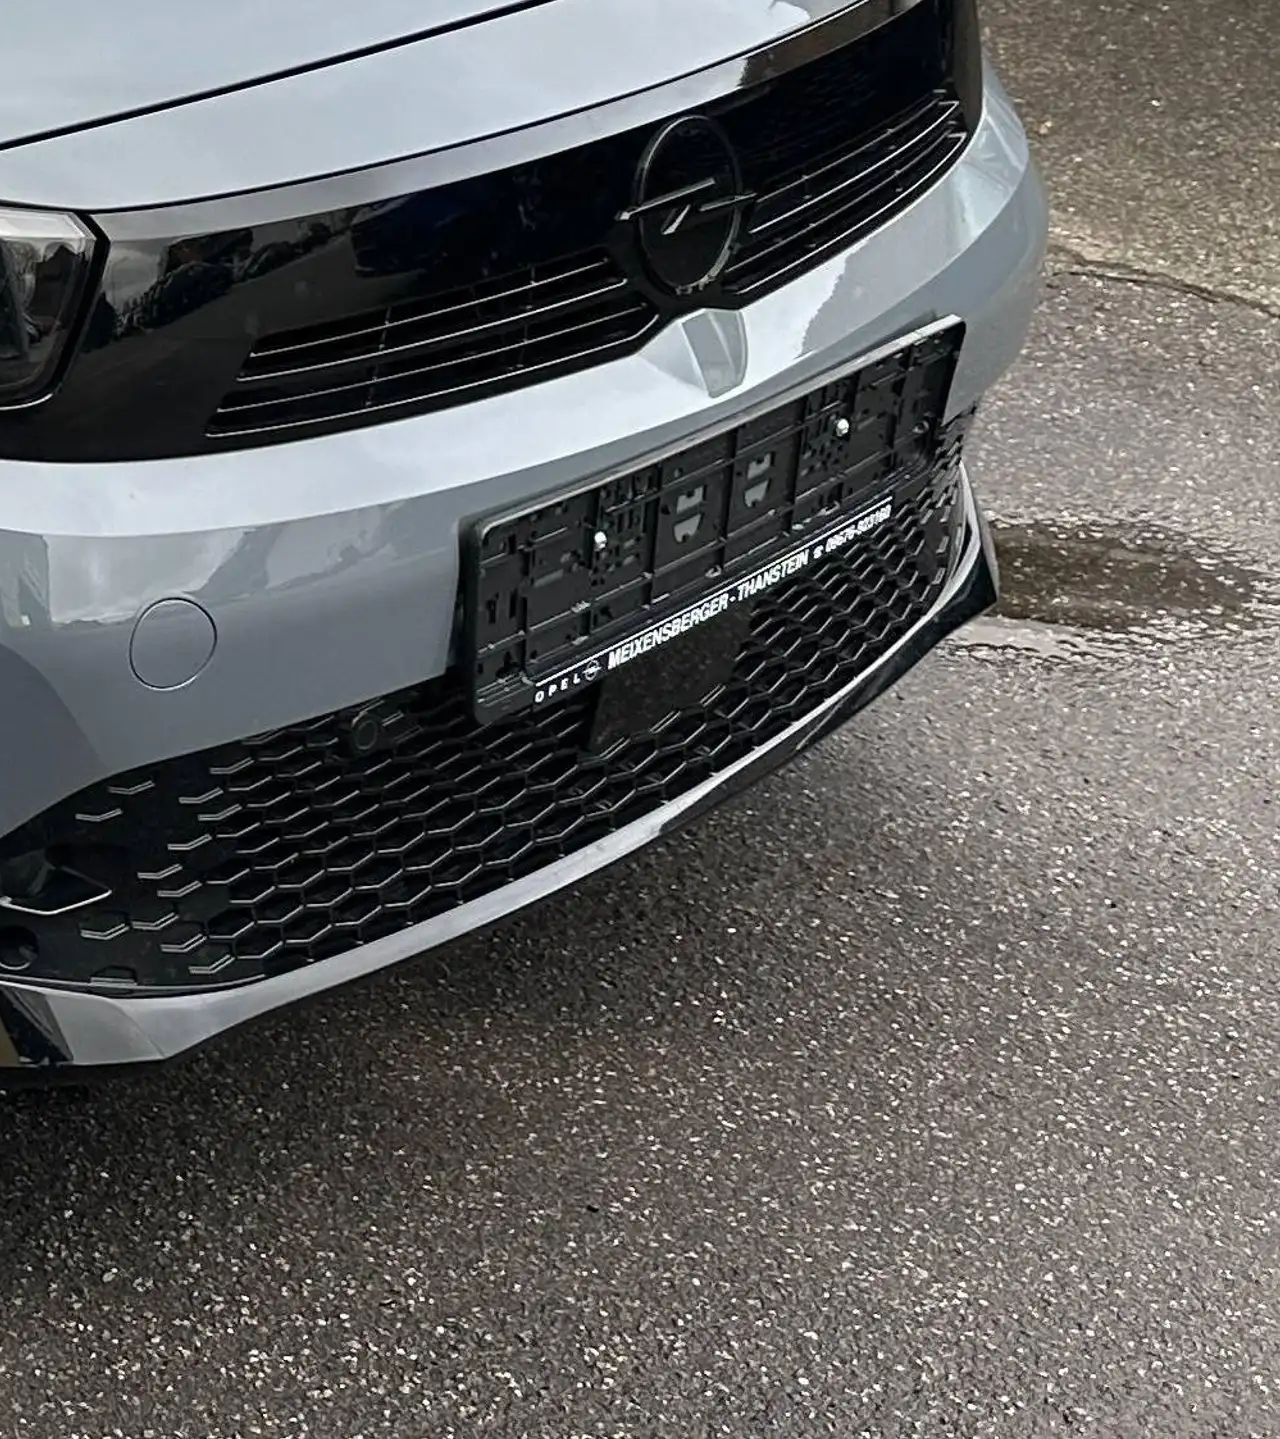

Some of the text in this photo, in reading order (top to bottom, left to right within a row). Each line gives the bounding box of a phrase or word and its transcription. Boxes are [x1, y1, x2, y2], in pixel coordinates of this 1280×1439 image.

[534, 673, 581, 703] OPEL
[607, 592, 729, 670] MEIXENSBERGER
[737, 549, 810, 601] THANSTEIN
